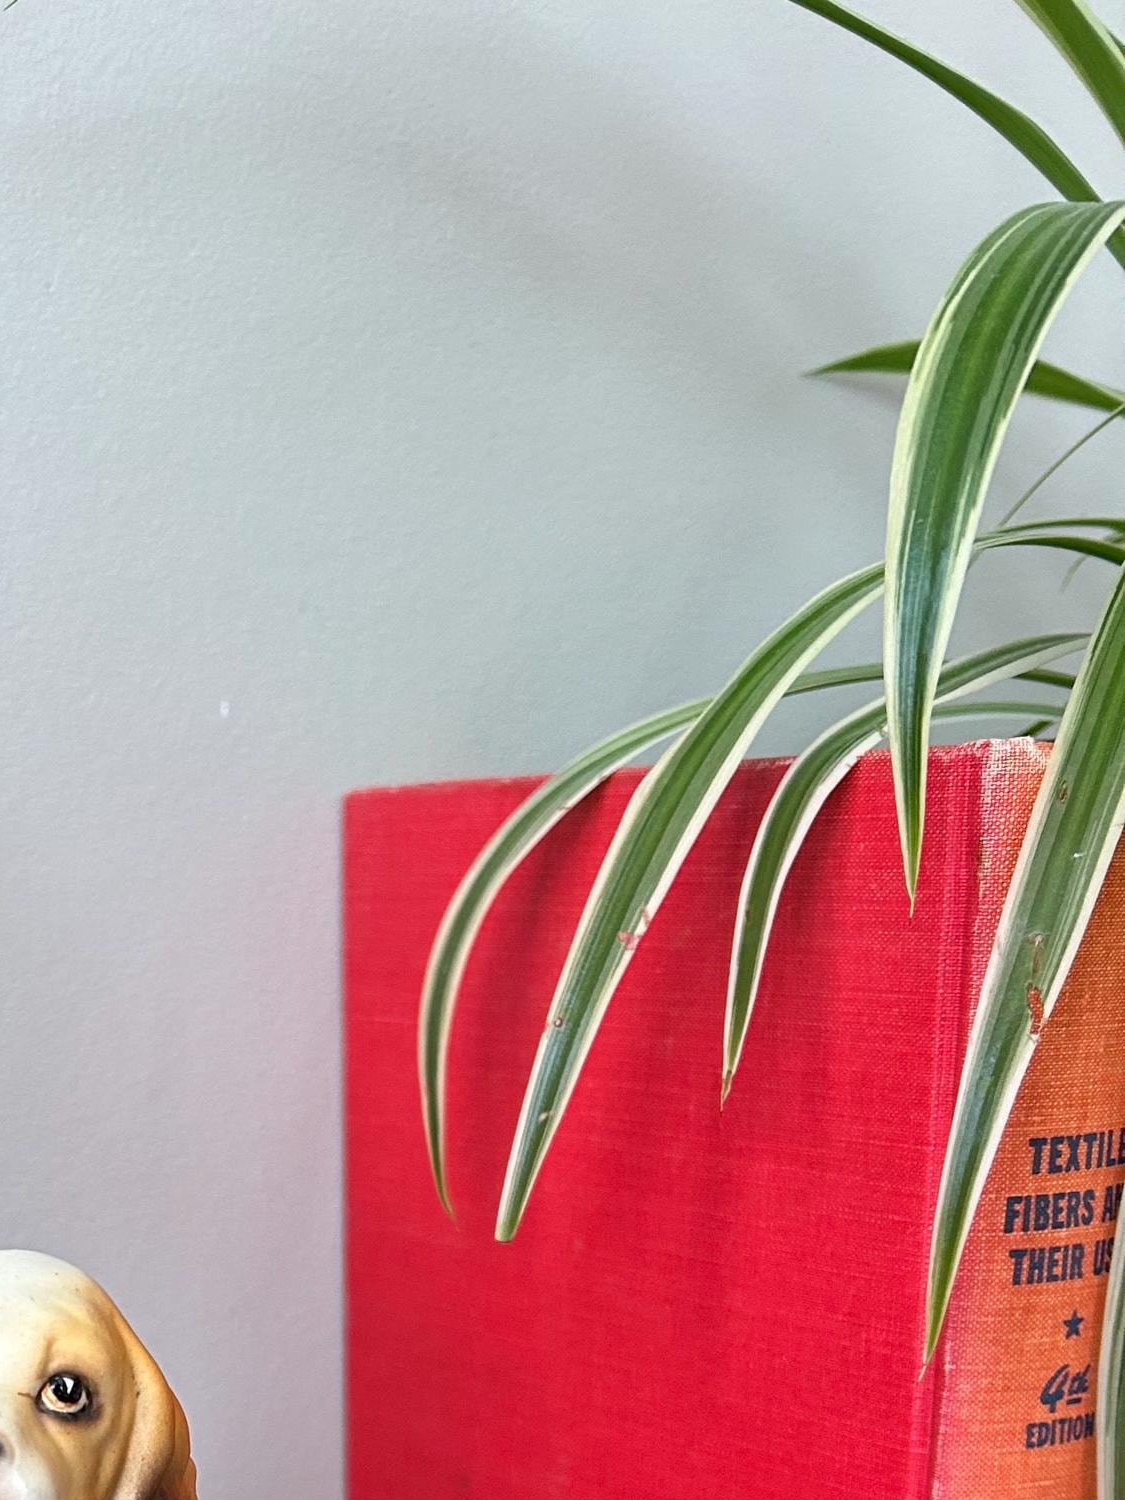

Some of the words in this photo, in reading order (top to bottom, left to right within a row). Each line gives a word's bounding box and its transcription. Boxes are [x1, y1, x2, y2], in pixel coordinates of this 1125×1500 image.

[1003, 1190, 1094, 1234] FIBERS
[1102, 1183, 1124, 1223] AN
[1009, 1243, 1084, 1286] THEIR
[1093, 1237, 1115, 1276] US
[1026, 1411, 1095, 1449] EDITION
